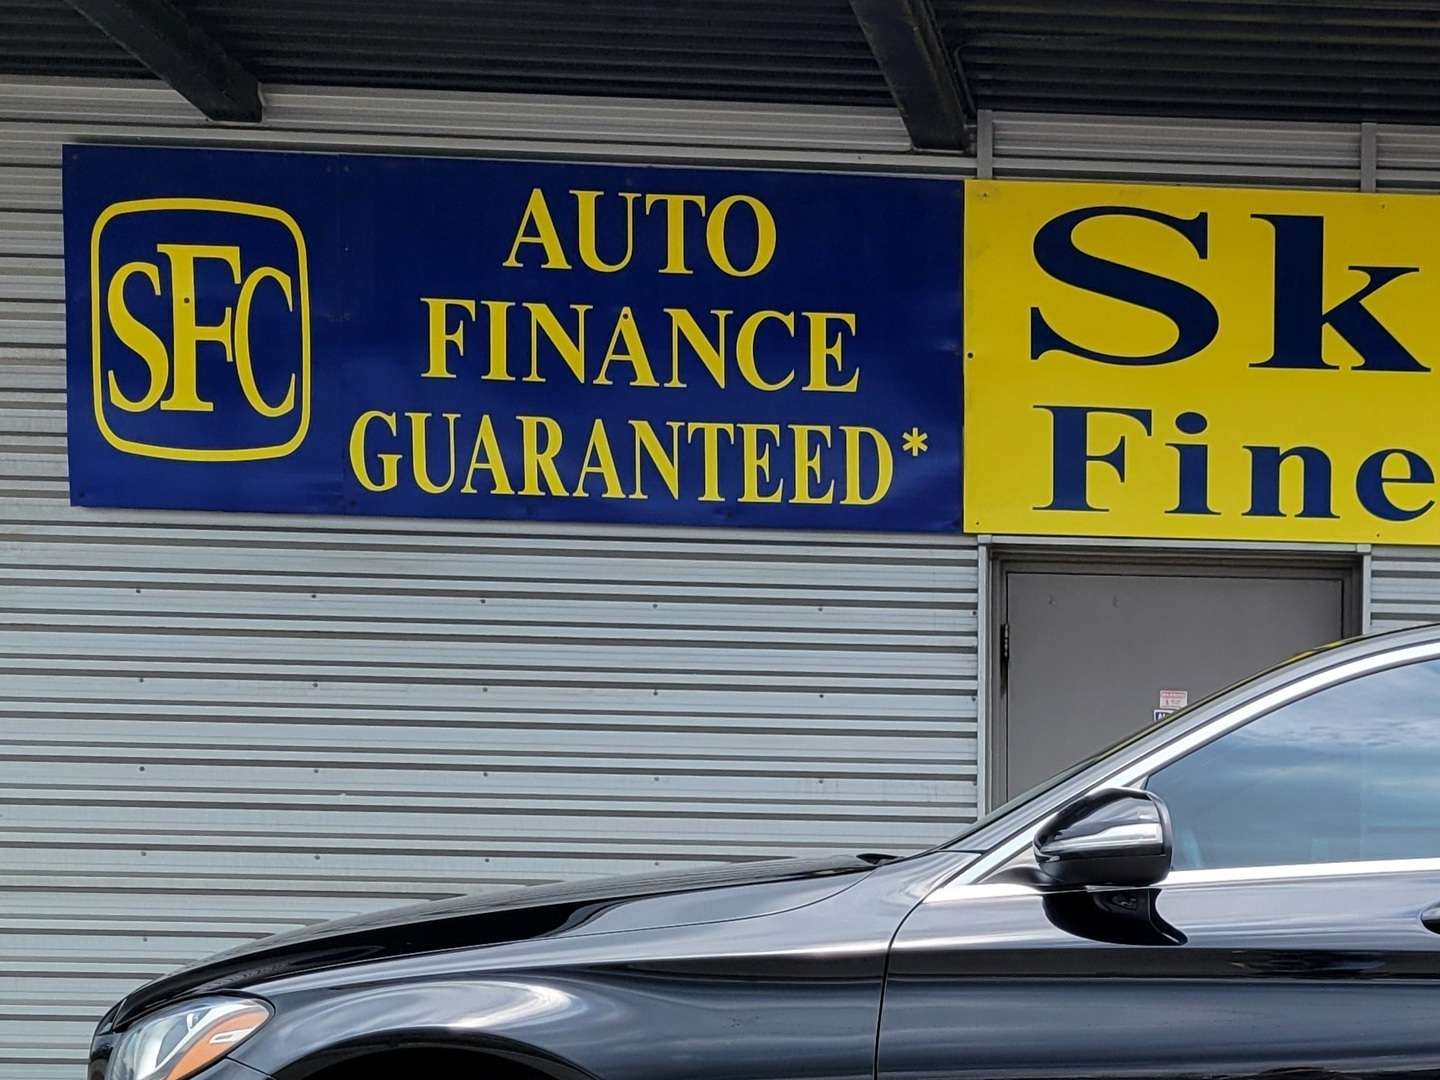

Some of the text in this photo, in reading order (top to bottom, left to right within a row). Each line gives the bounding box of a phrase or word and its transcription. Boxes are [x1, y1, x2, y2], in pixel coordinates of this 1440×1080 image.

[503, 188, 777, 277] AUTO
[107, 243, 296, 418] SFC
[420, 297, 859, 392] FINANCE
[1035, 404, 1436, 522] Fine
